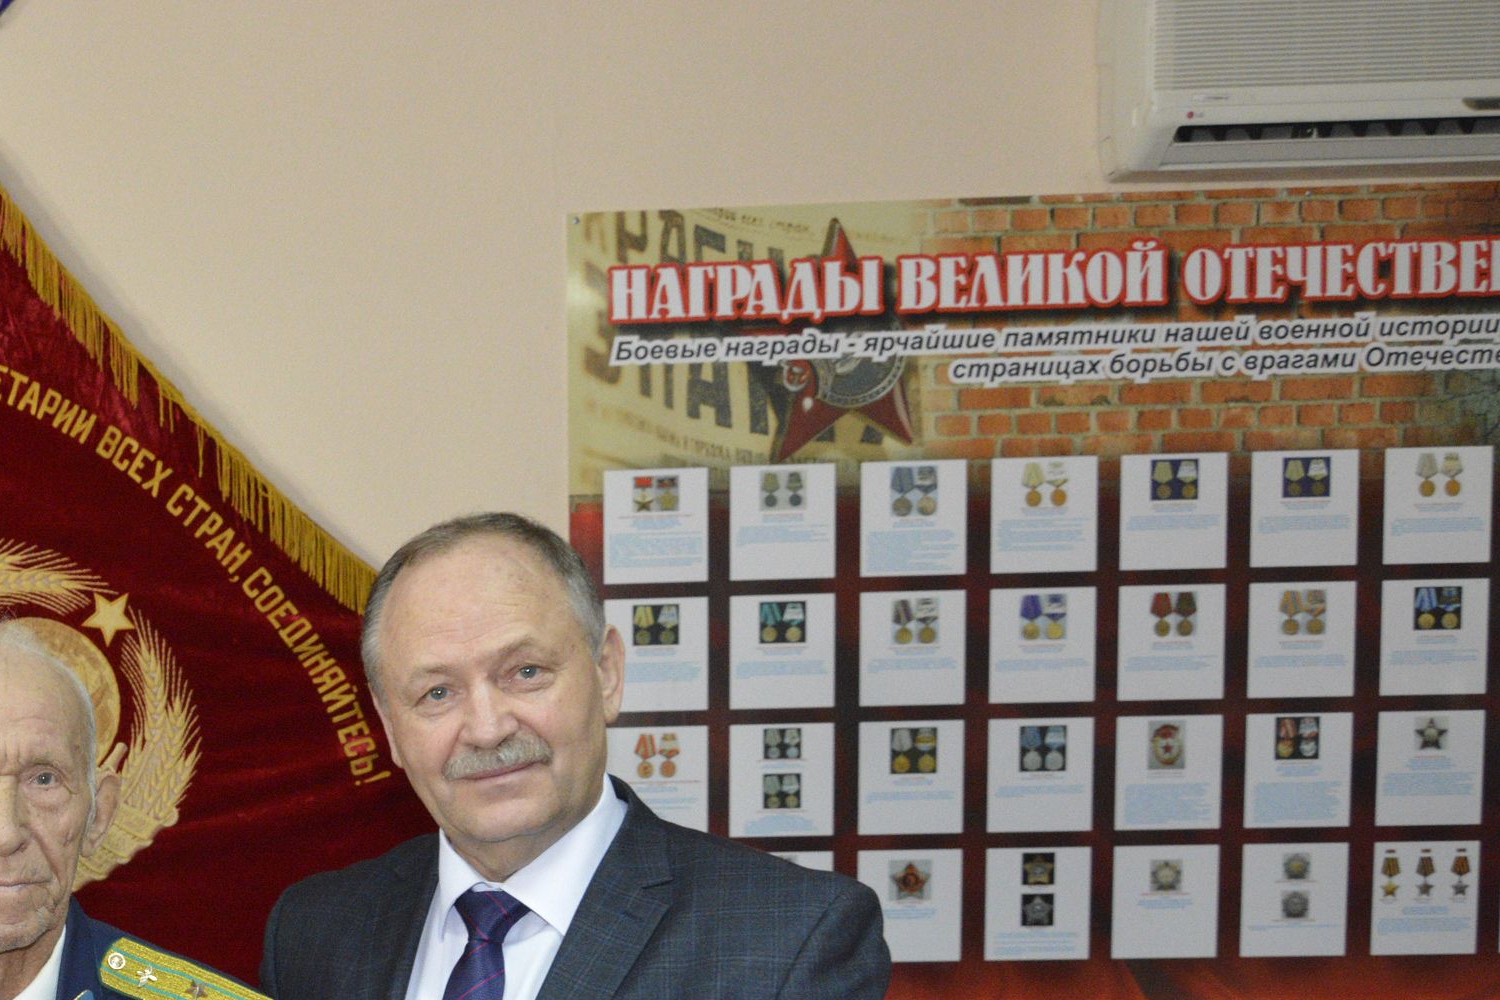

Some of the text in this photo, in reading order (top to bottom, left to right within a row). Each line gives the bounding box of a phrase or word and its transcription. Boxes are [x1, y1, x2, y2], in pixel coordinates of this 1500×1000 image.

[610, 256, 883, 321] НАГРАДЫ
[898, 242, 1167, 310] ВЕЛИКОЙ
[615, 314, 1499, 361] Боевые награды ярчайшие памятники нашей военной истории
[953, 358, 1099, 382] страницах
[1110, 351, 1213, 376] борьбы
[1222, 355, 1236, 371] с
[1245, 351, 1356, 373] врагами
[96, 425, 173, 498] ВСЕХ
[166, 483, 252, 585] СТРАН,
[242, 566, 392, 787] СОЕДИНЯЙТЕСЬ!
